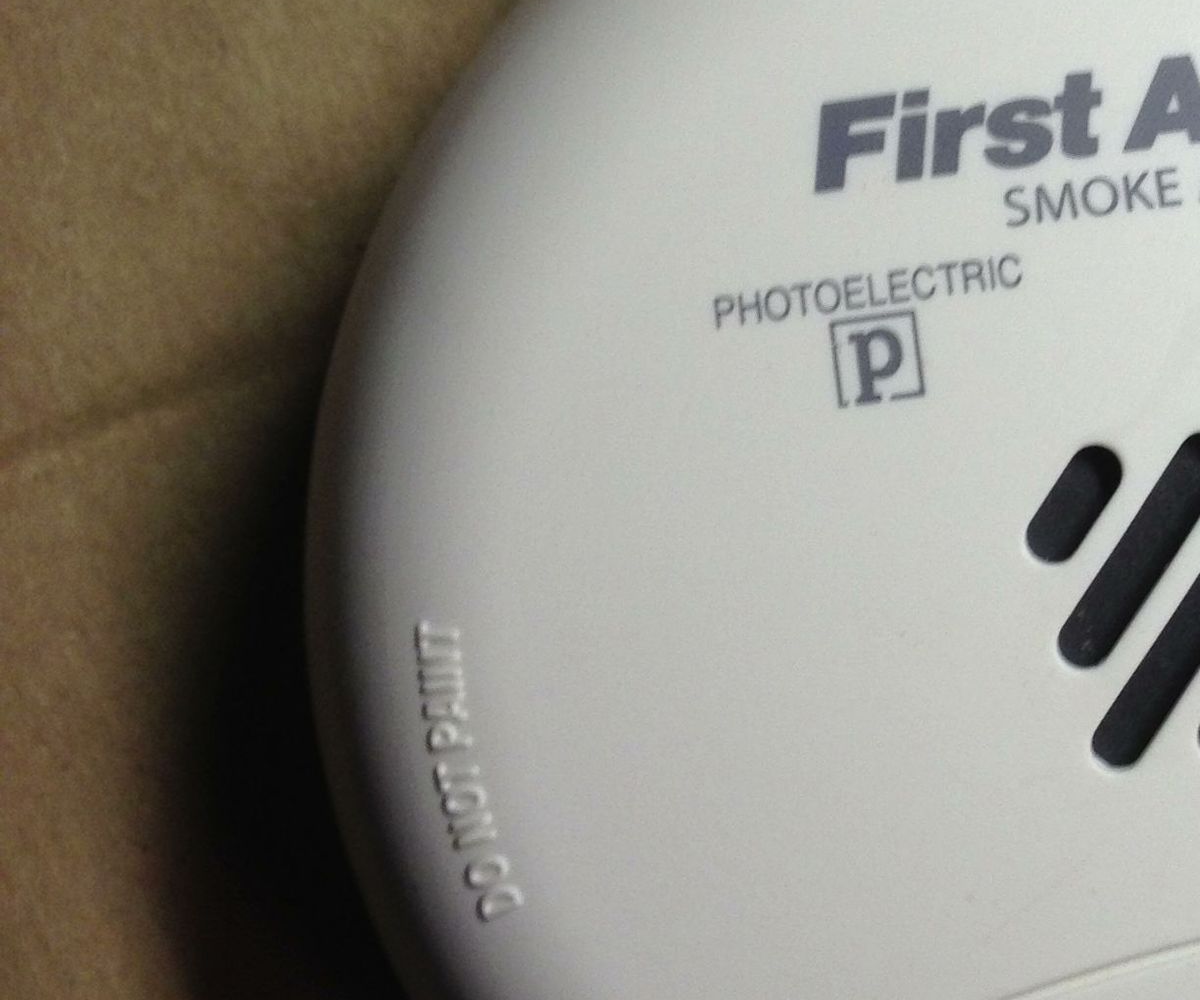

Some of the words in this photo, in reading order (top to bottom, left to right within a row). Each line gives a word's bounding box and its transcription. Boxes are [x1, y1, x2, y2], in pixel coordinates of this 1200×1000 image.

[813, 69, 1104, 196] First
[1003, 166, 1183, 229] SMOKE
[713, 252, 1023, 330] PHOTOELECTRIC
[415, 619, 476, 754] PAINT
[433, 760, 499, 851] NOT
[464, 852, 525, 923] DO
